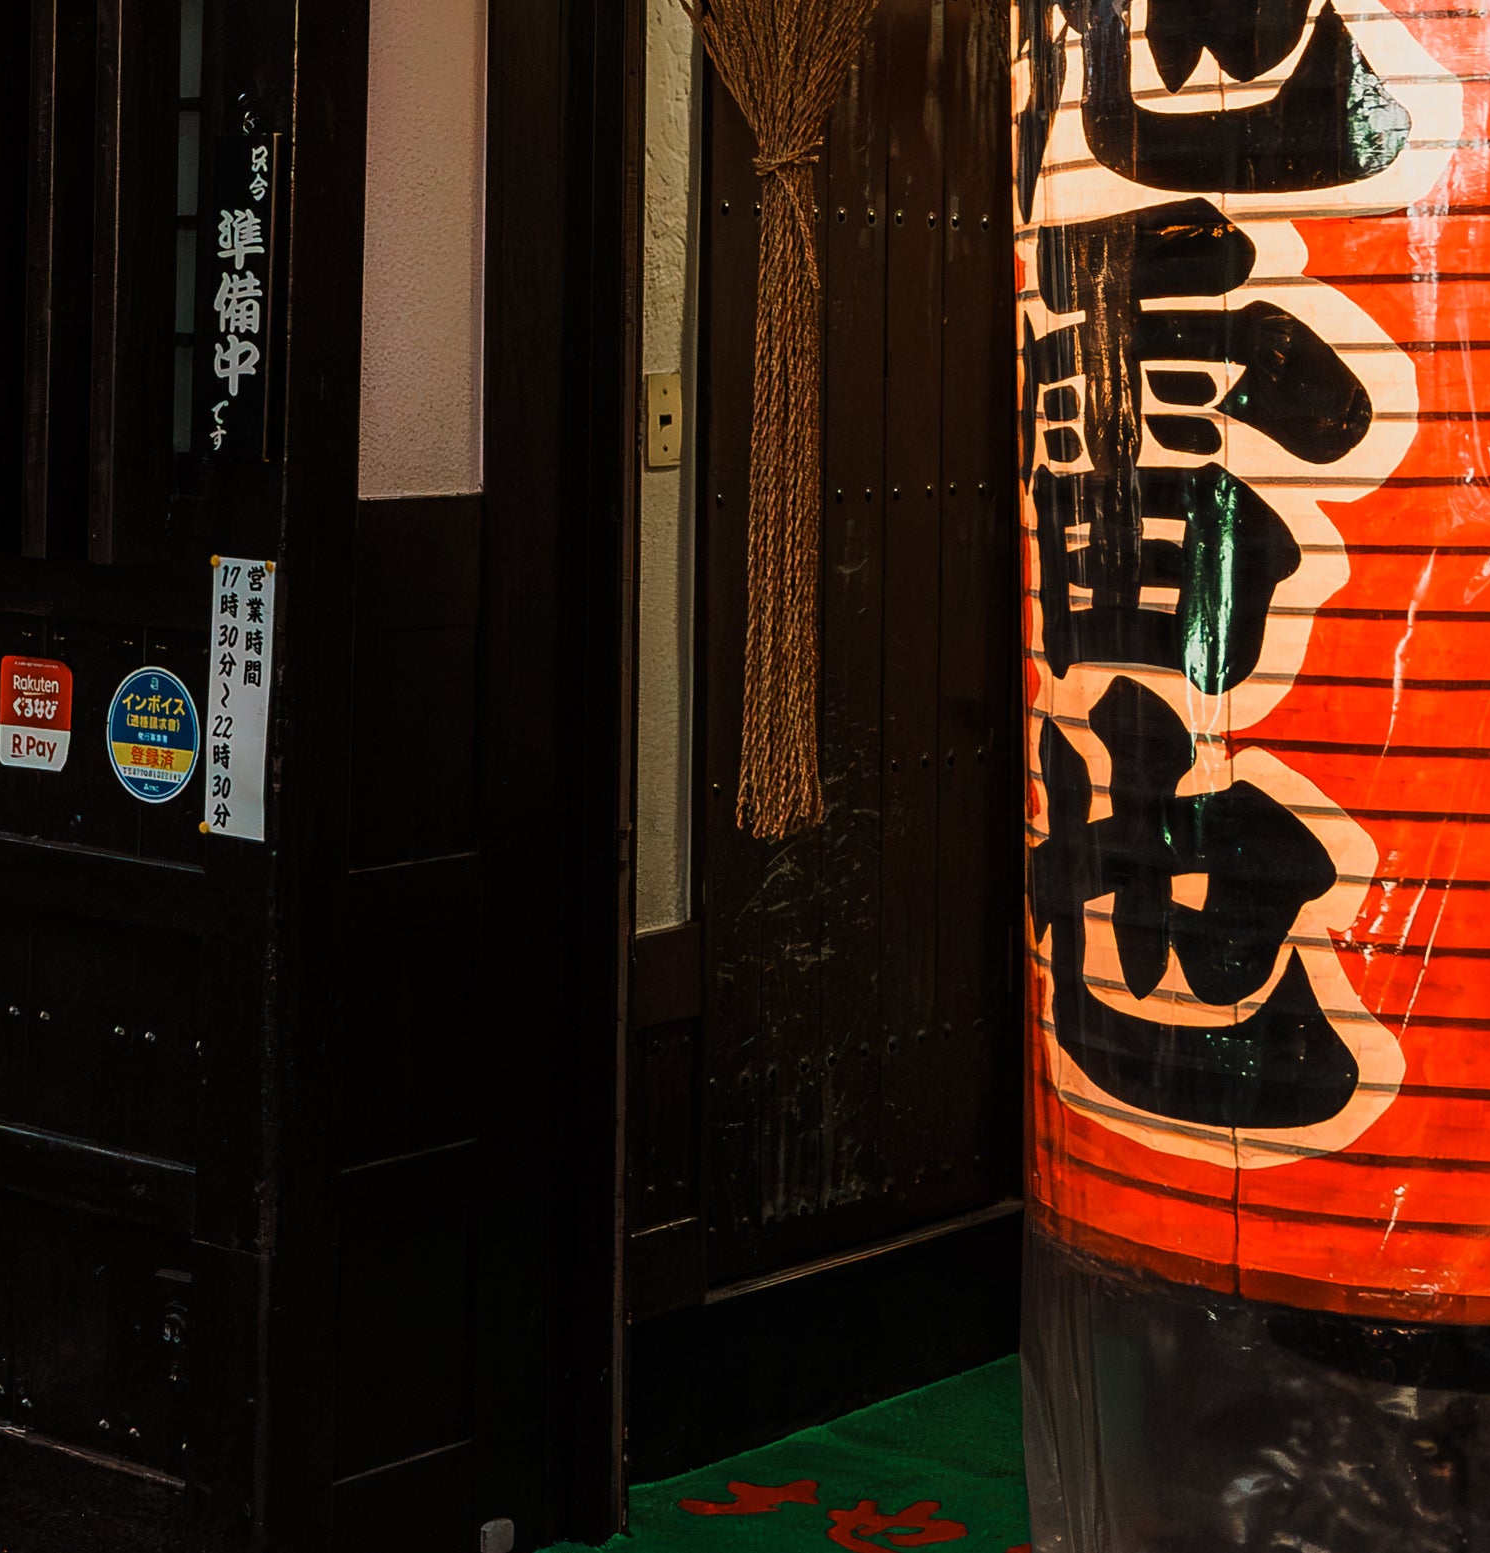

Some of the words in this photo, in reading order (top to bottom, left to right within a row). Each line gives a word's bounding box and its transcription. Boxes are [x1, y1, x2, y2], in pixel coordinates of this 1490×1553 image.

[243, 565, 266, 688] 営業時間
[12, 674, 60, 694] Rakuten
[12, 696, 59, 720] ぐるなび
[121, 693, 186, 717] インボイス
[25, 735, 58, 763] Pay
[130, 745, 175, 770] 登録済
